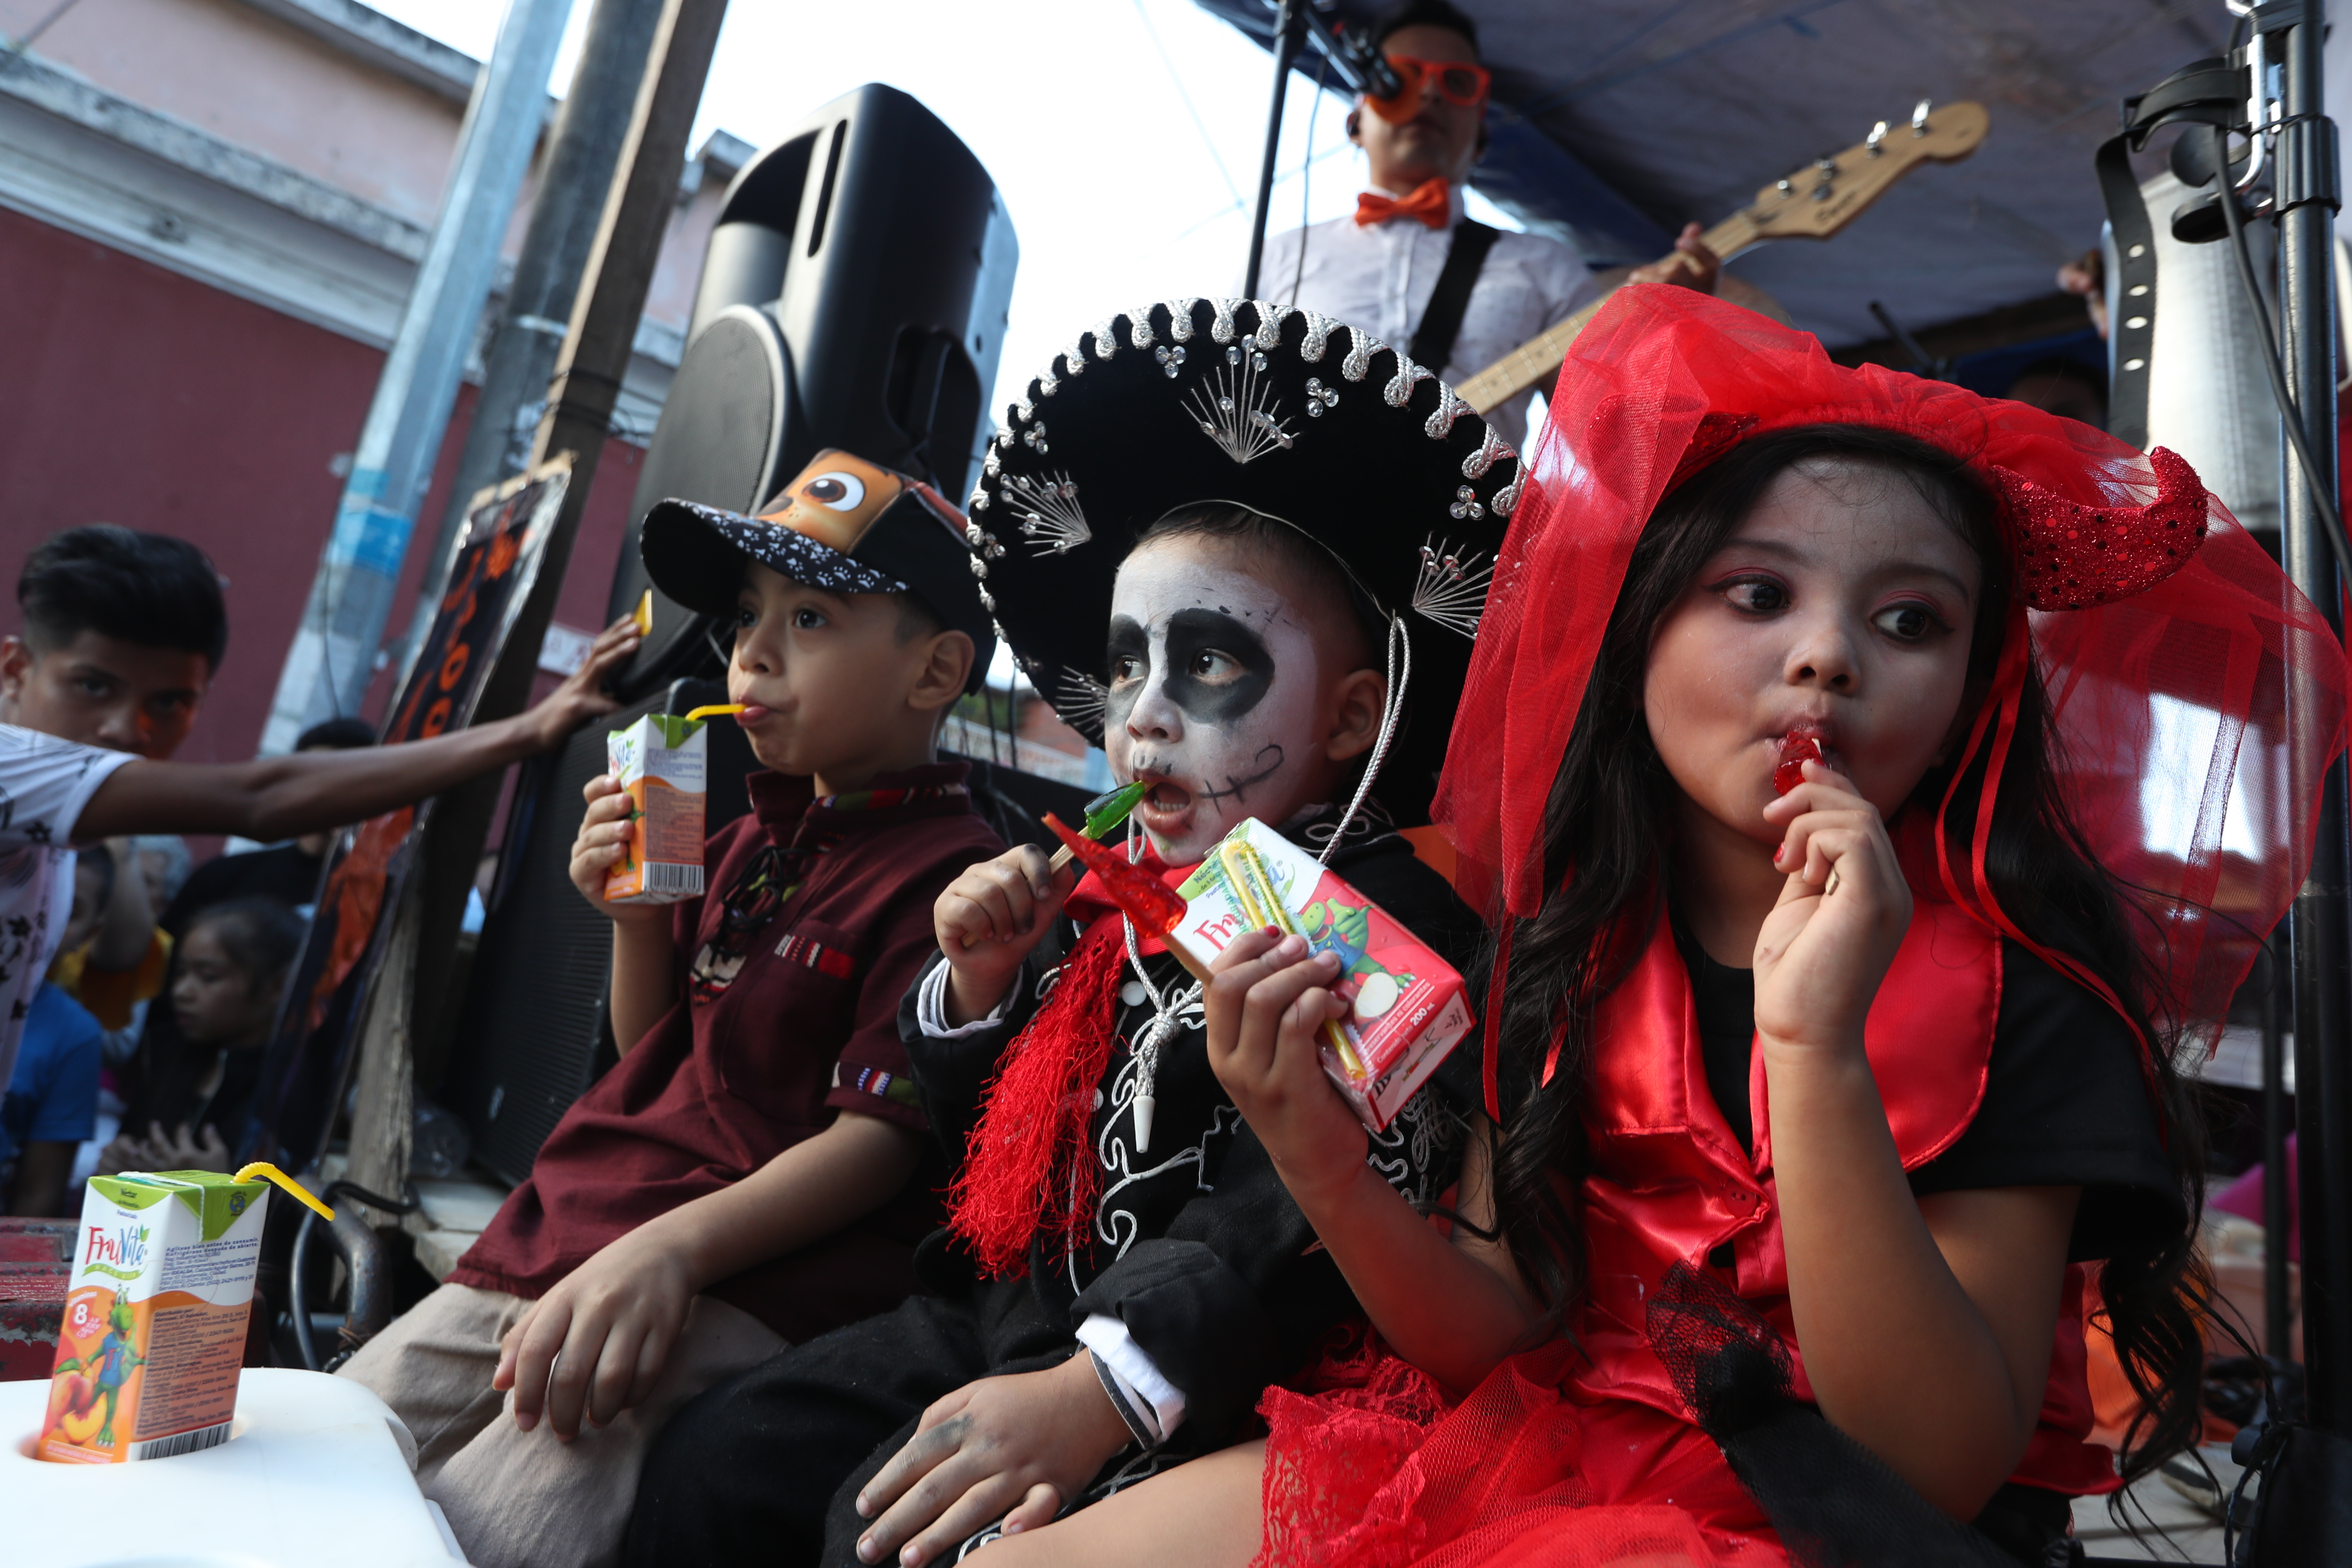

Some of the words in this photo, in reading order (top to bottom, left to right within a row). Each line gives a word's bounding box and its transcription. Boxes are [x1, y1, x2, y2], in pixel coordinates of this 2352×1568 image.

[1409, 1007, 1429, 1026] 200
[85, 1225, 145, 1266] FruVita
[68, 1291, 98, 1308] vitaminas
[73, 1303, 89, 1325] 8
